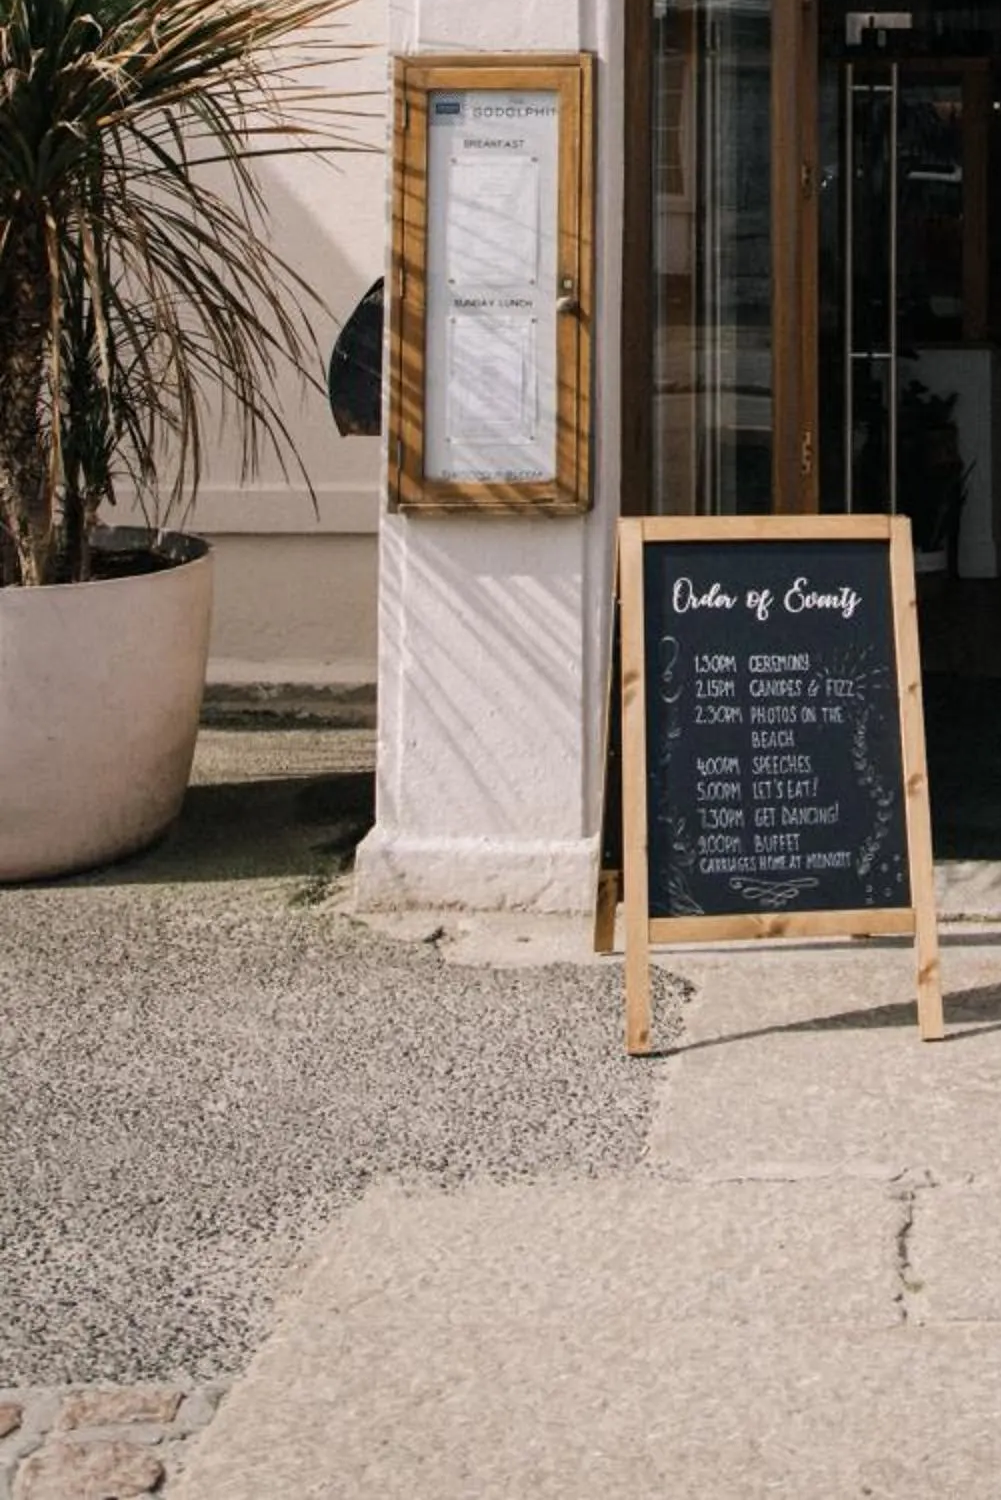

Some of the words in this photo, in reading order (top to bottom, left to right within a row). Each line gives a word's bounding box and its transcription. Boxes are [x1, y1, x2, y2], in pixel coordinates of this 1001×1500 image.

[673, 577, 738, 613] Order
[746, 589, 774, 621] of
[784, 577, 863, 619] Events
[749, 653, 810, 673] CEREMONY
[808, 679, 820, 697] &
[826, 679, 855, 697] FIZZ
[751, 706, 797, 724] PHOTOS
[801, 706, 817, 724] ON
[822, 706, 845, 723] THE
[751, 729, 795, 749] BEACH
[752, 755, 812, 775] SPEECHES
[752, 780, 784, 800] LET'S
[754, 807, 776, 827] GET
[781, 802, 839, 826] DANCING!
[754, 833, 801, 853] BUFFET
[788, 855, 801, 870] AT
